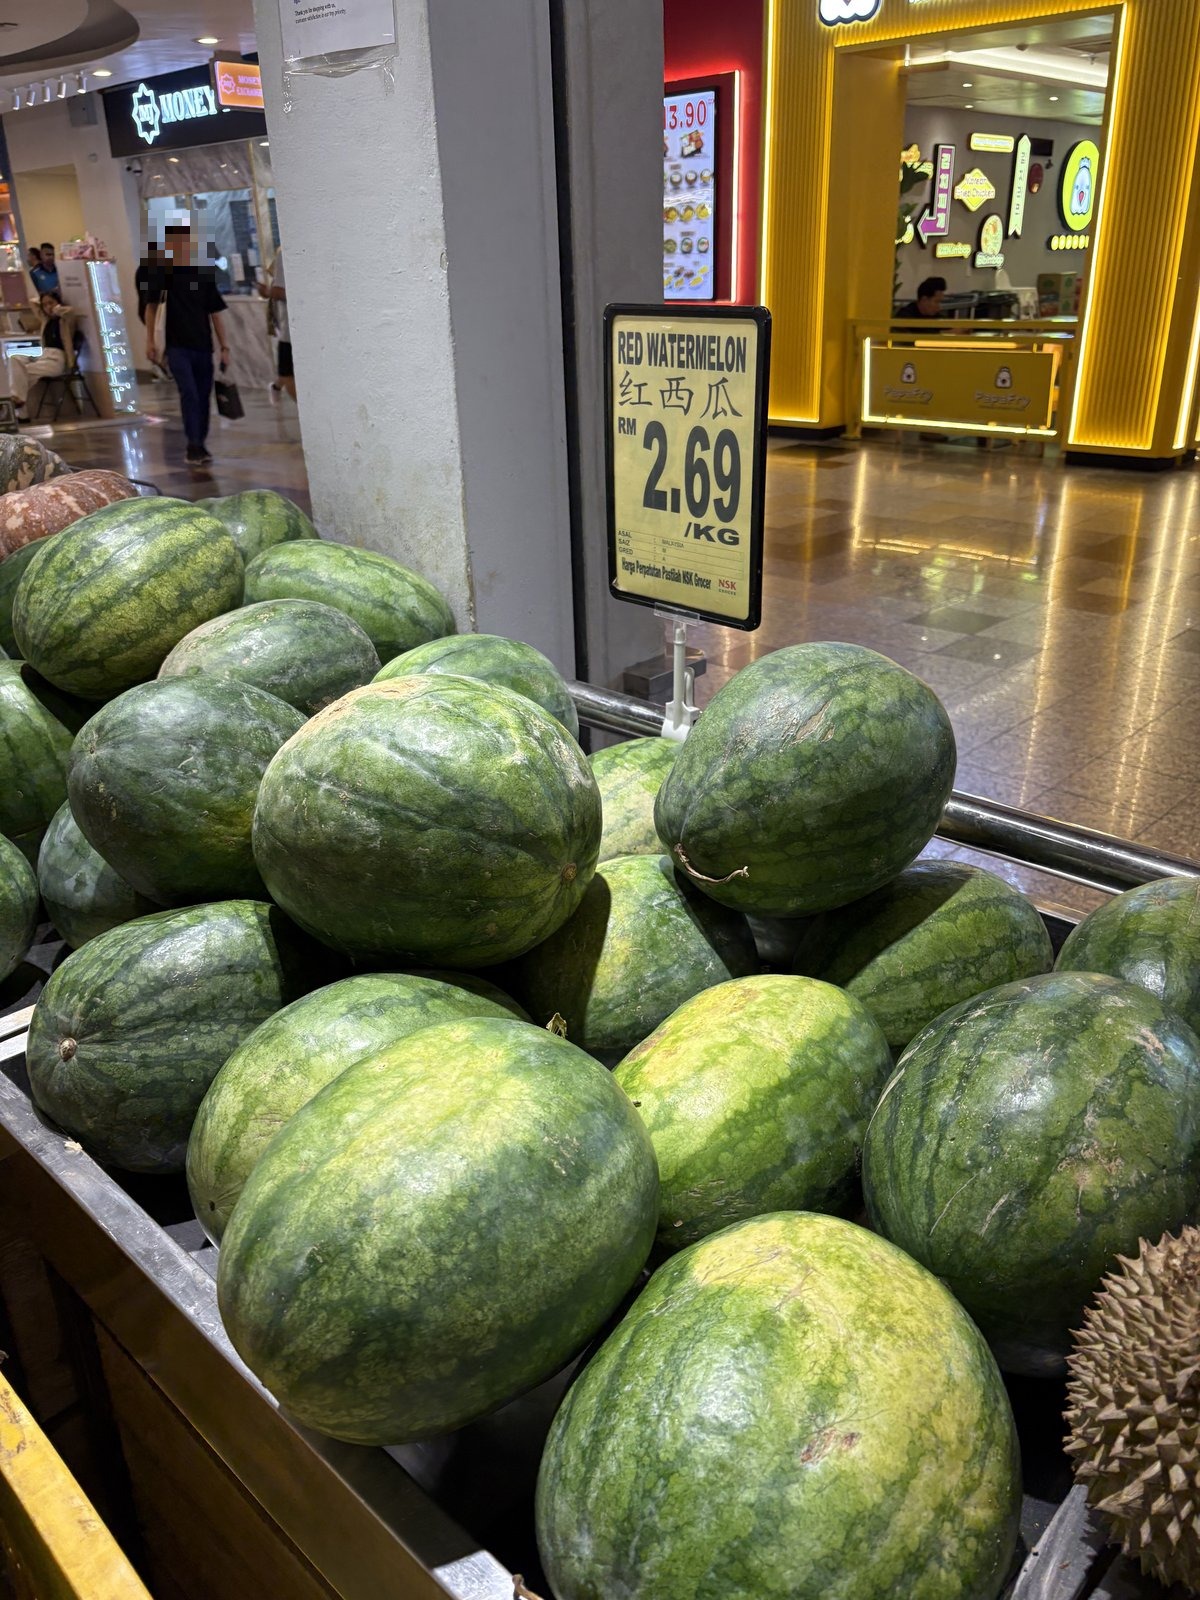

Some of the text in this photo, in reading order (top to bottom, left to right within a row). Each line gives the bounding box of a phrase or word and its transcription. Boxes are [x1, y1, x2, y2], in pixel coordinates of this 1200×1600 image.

[159, 86, 217, 123] MONEY
[618, 331, 747, 373] RED WATERMELON
[619, 370, 743, 420] 红西瓜
[618, 416, 741, 523] RM 2.69
[618, 530, 632, 538] ASAL
[618, 538, 630, 546] SAIZ
[684, 522, 740, 546] /KG
[618, 546, 633, 555] GRED
[622, 557, 635, 575] Harga
[682, 570, 694, 586] NSK
[694, 573, 711, 589] Grocer
[718, 579, 737, 590] NSK
